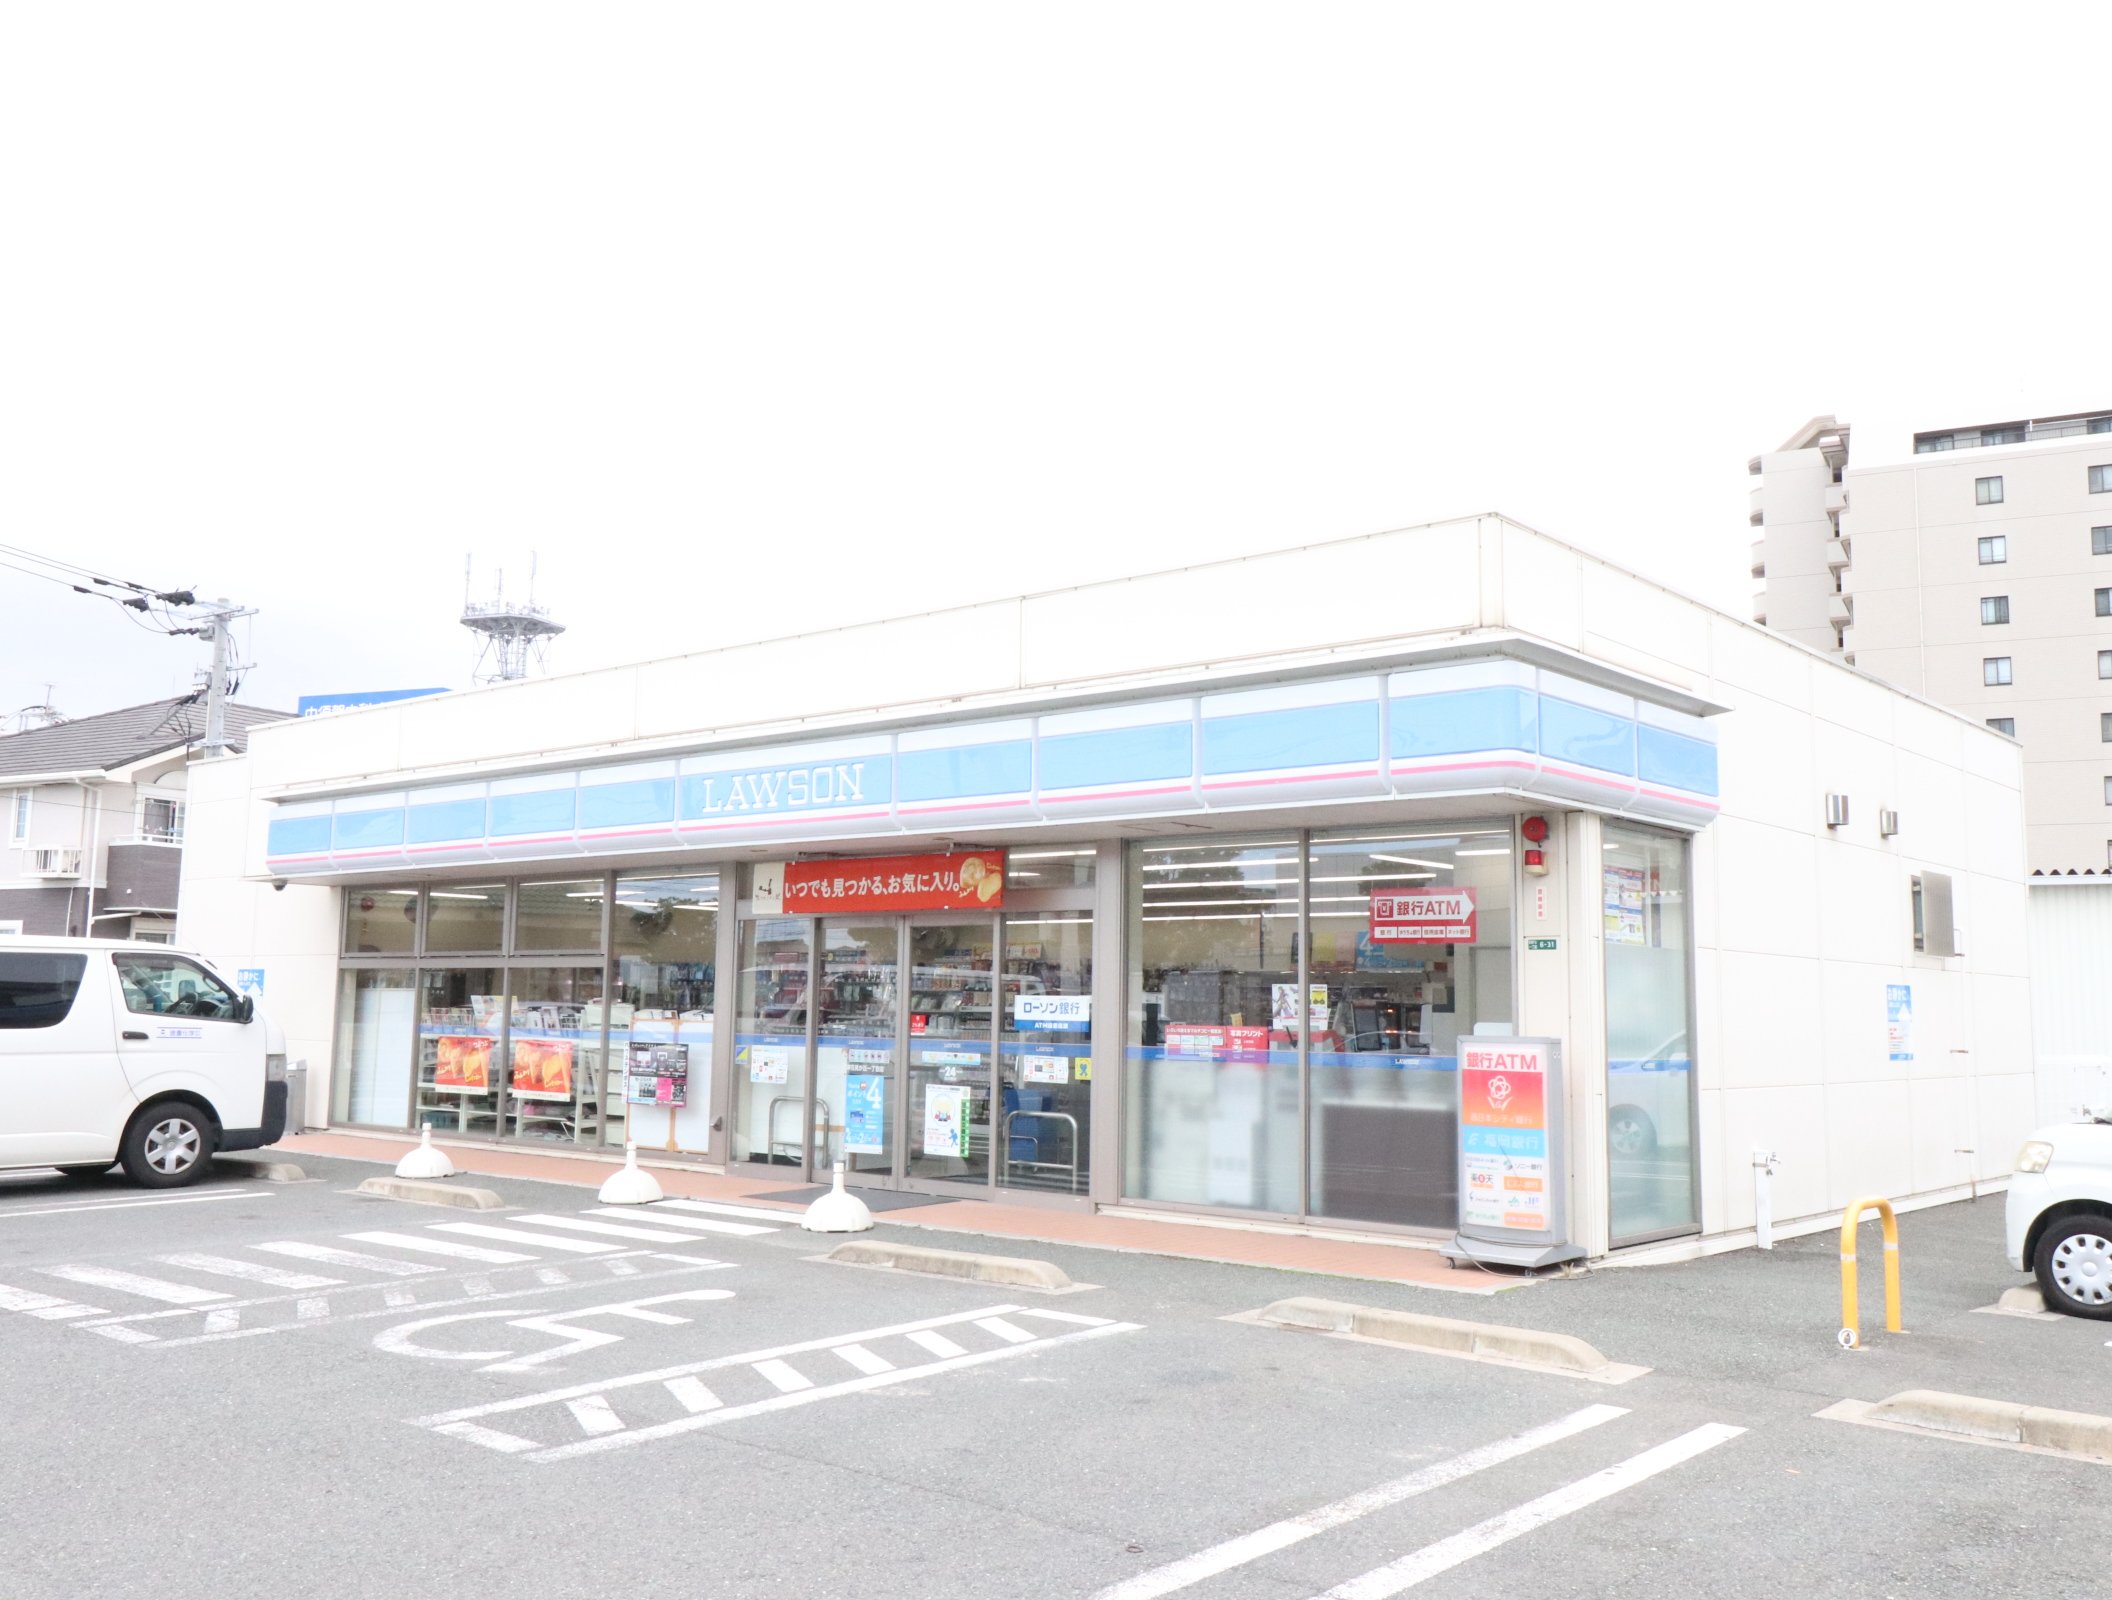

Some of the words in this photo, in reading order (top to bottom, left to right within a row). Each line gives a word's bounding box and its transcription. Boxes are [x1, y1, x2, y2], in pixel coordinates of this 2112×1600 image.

[702, 762, 865, 813] LAWSON
[785, 871, 960, 898] いつでも見つかる、お気に入り。
[1397, 900, 1461, 916] 銀行ATM
[1024, 1002, 1080, 1015] ローソン銀行
[1466, 1052, 1537, 1070] 銀行ATM
